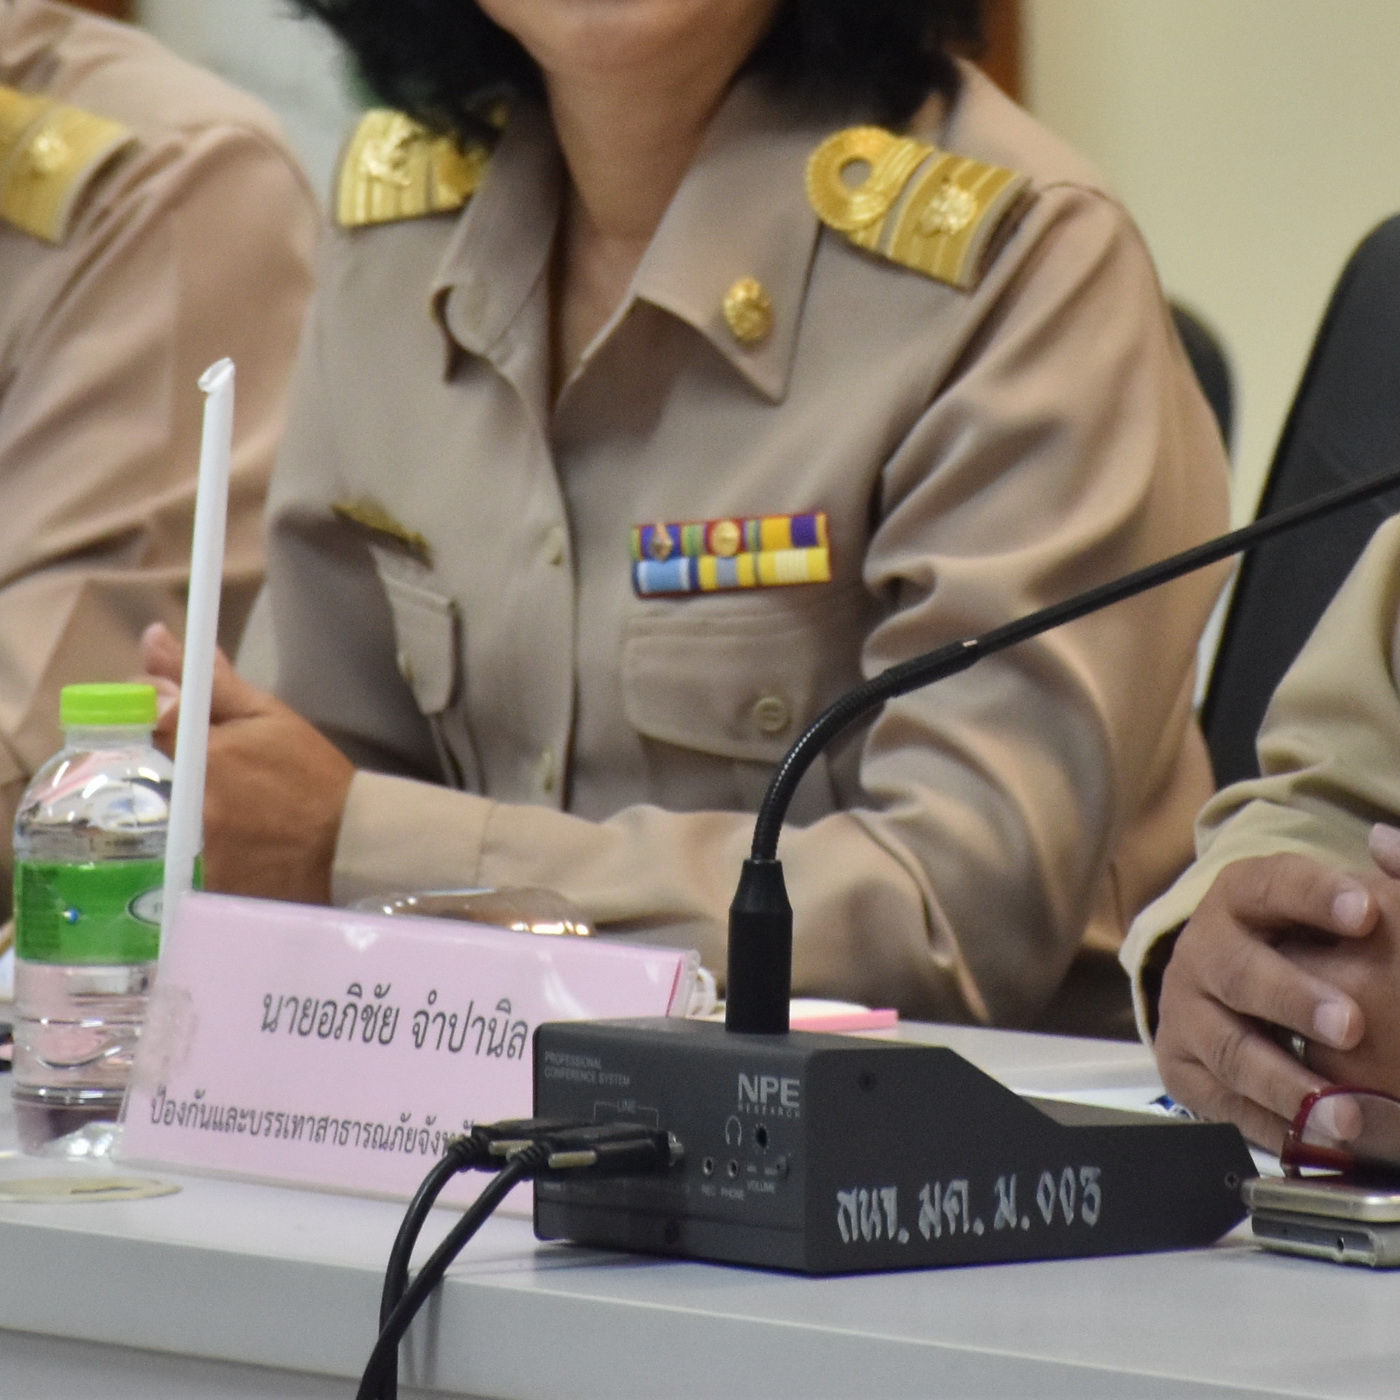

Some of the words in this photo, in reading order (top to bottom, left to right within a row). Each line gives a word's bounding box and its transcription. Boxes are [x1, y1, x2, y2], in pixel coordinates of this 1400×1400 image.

[259, 981, 402, 1046] นายอภิชัย
[411, 988, 531, 1061] จำปานิล
[737, 1072, 800, 1109] NPE
[736, 1105, 800, 1119] RESEARCH
